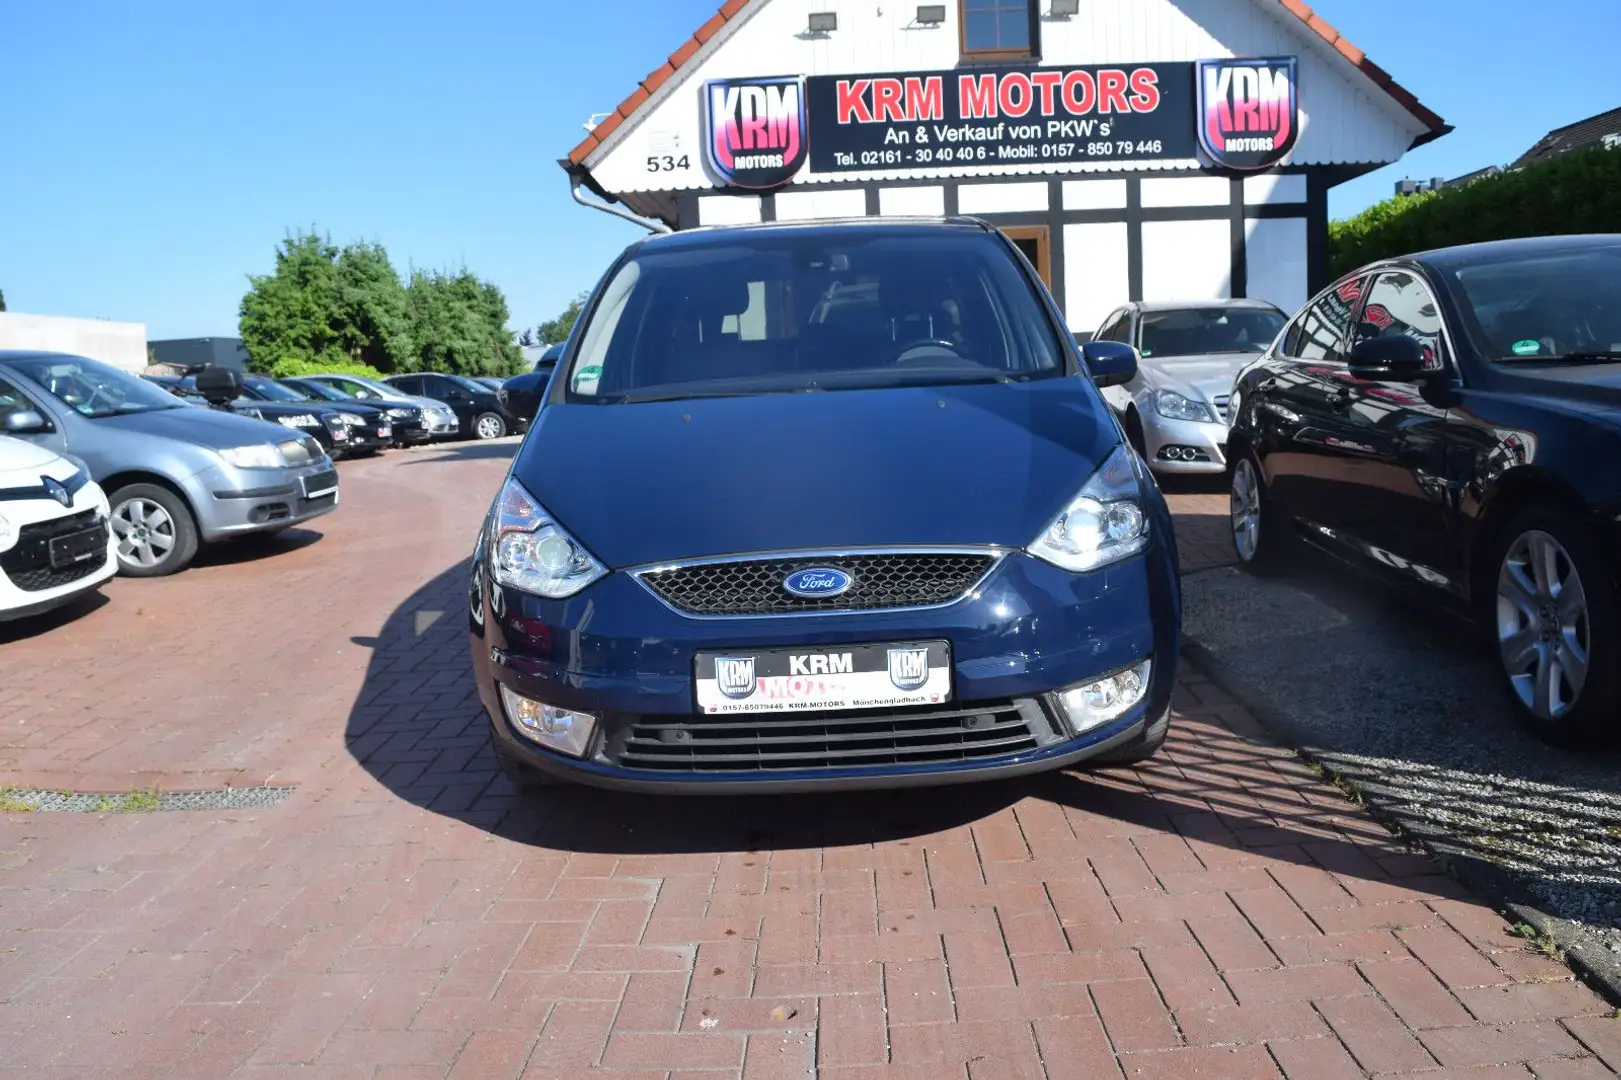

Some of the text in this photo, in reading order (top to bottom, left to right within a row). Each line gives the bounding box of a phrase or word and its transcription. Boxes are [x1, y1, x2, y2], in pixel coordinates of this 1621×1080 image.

[836, 68, 1160, 125] KRM MOTORS
[1204, 66, 1290, 151] KRM
[713, 84, 800, 167] KRM
[884, 126, 910, 145] An
[915, 125, 929, 144] &
[933, 122, 1005, 142] Verkauf
[1008, 124, 1042, 140] von
[834, 152, 857, 166] Tel.
[861, 150, 902, 165] 02161
[915, 149, 933, 162] 30
[935, 147, 953, 161] 40
[956, 147, 974, 160] 40
[976, 146, 986, 160] 6
[1041, 143, 1075, 157] 0157
[1087, 142, 1113, 156] 850
[1116, 141, 1133, 154] 79
[1136, 140, 1162, 154] 446
[1225, 137, 1274, 152] MOTORS
[647, 154, 690, 172] 534
[734, 154, 783, 169] MOTORS
[799, 574, 835, 589] Ford
[718, 660, 753, 686] KRM
[789, 652, 853, 675] KRM
[891, 652, 925, 676] KRM
